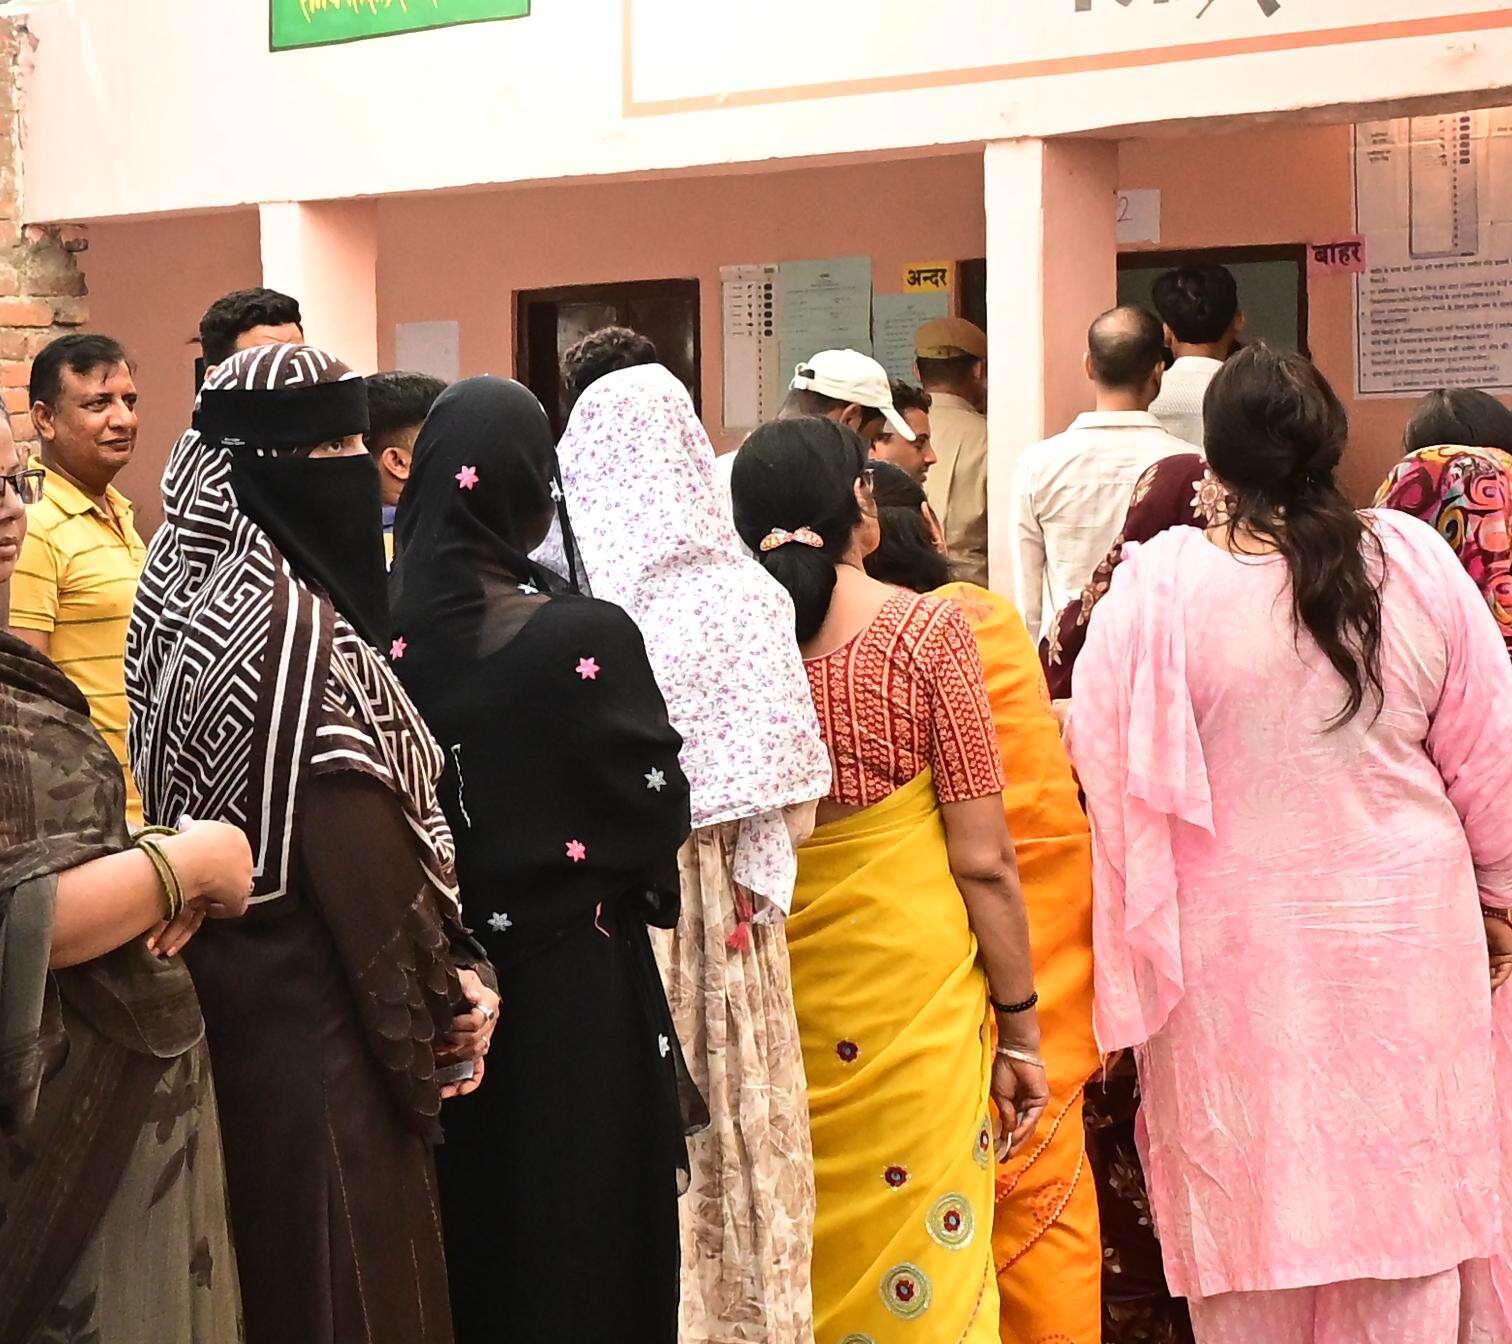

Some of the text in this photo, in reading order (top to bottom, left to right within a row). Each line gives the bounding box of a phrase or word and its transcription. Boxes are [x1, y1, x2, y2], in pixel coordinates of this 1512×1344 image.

[1117, 196, 1132, 222] 2
[1311, 242, 1362, 266] बाहर
[907, 267, 948, 287] अन्दर
